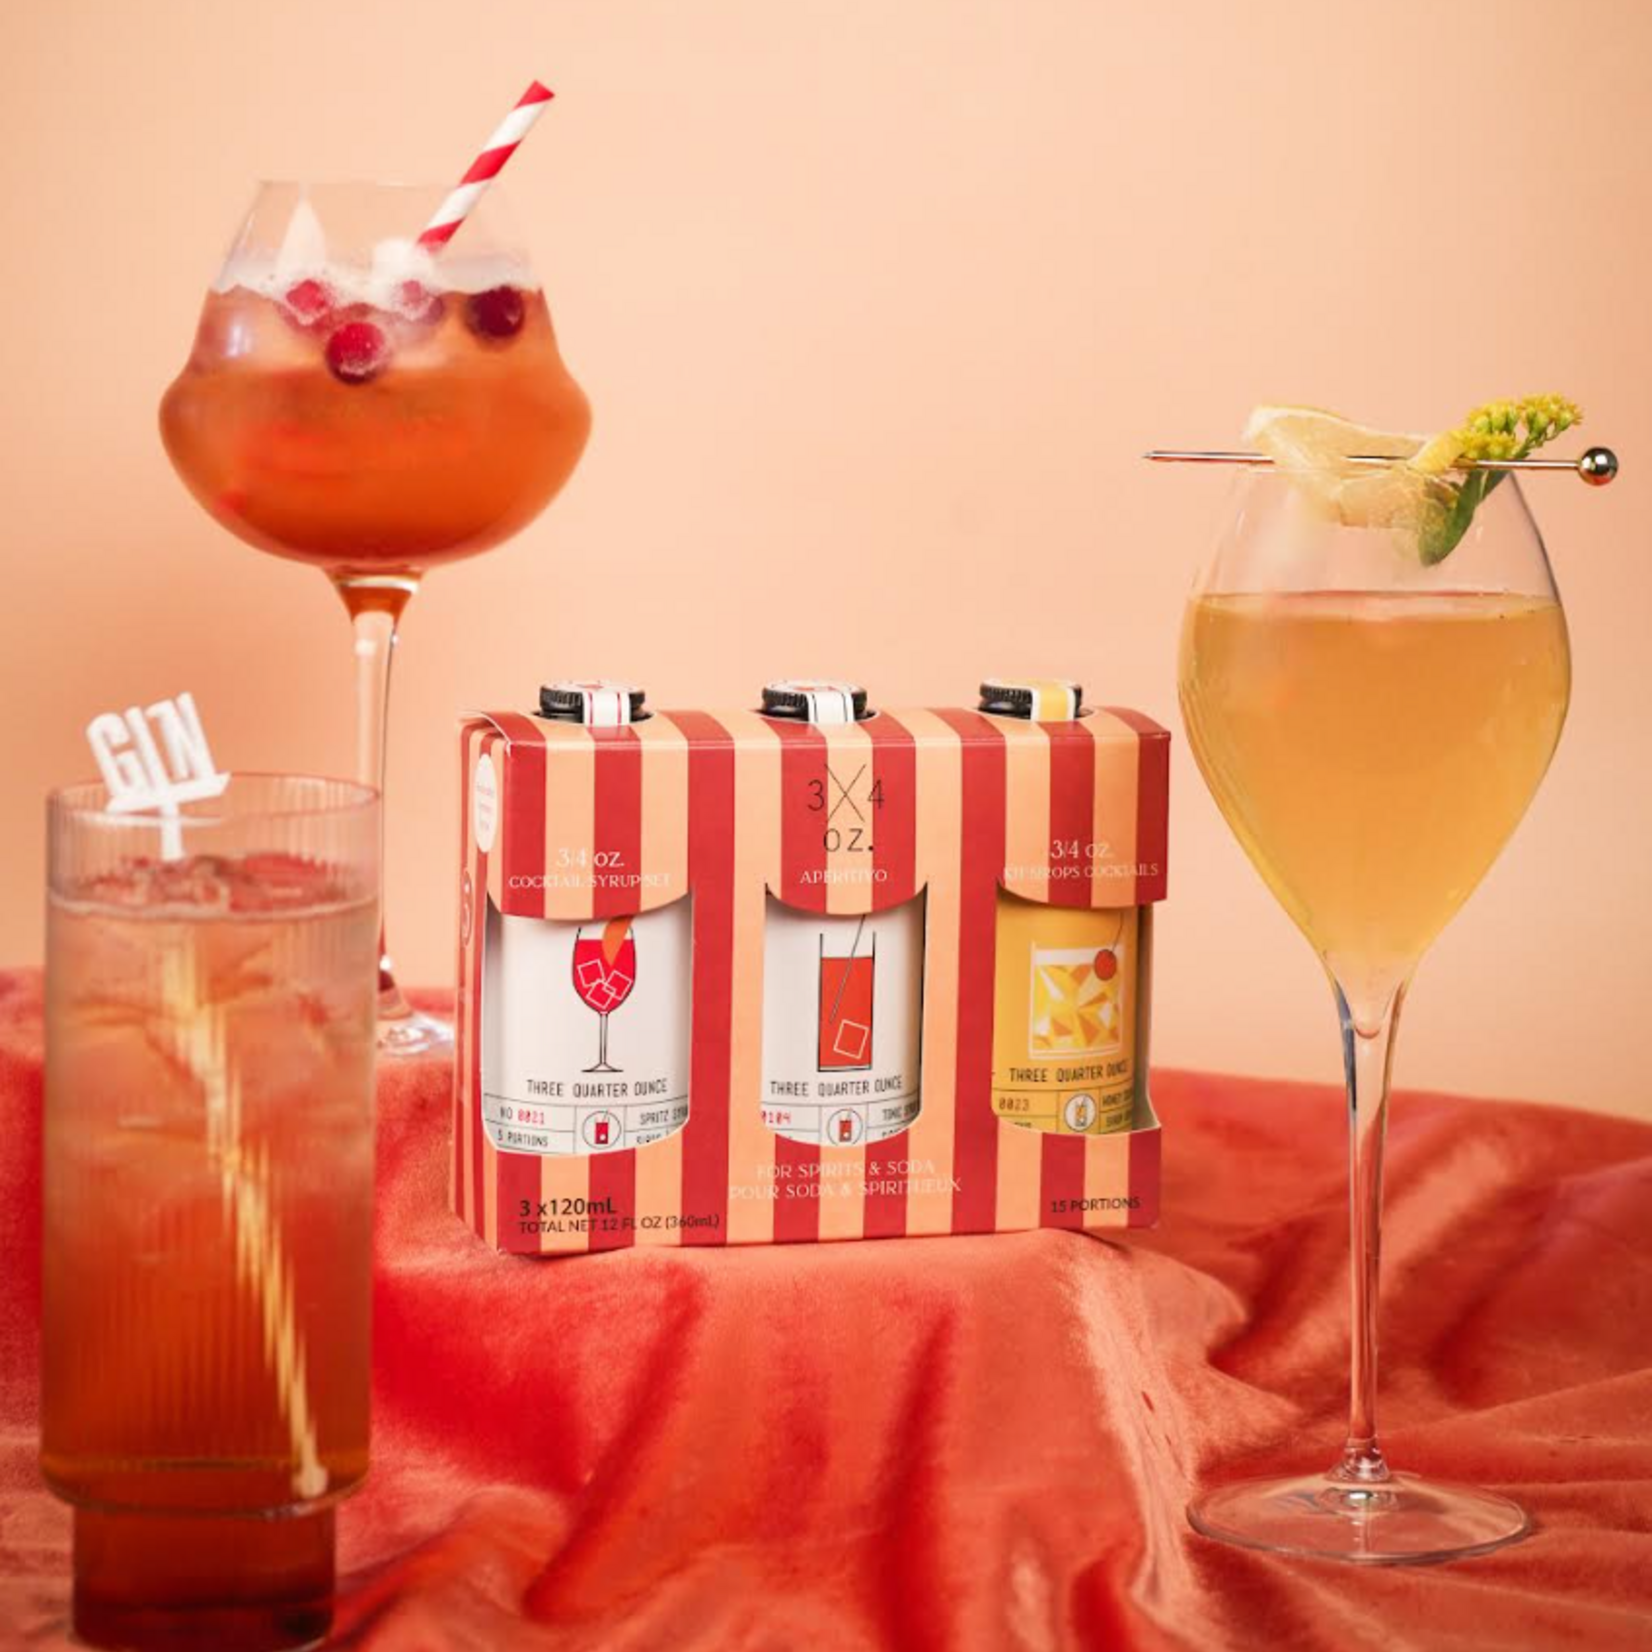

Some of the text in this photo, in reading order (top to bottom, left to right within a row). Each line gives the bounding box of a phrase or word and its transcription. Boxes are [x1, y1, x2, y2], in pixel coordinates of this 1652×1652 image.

[86, 690, 217, 798] GIN
[1051, 839, 1079, 859] 3/4
[800, 868, 888, 884] APERITIVO
[1084, 862, 1159, 878] COCKTAILS
[508, 874, 582, 889] COCKTAIL
[592, 874, 639, 888] SYRUP
[1009, 1067, 1048, 1083] THREE
[1056, 1065, 1104, 1083] QUARTER
[527, 1078, 668, 1098] THREE QUARTER OUNCE
[770, 1075, 903, 1097] THREE QUARTER OUNCE
[999, 1097, 1030, 1112] 0023
[639, 1109, 669, 1125] SPRITZ
[507, 1131, 548, 1148] PORTIONS
[757, 1159, 935, 1179] FOR SPIRITS & SODA
[730, 1184, 780, 1200] POUR
[786, 1182, 834, 1198] SODA
[860, 1176, 962, 1195] SPIRITUEUX
[1051, 1197, 1141, 1213] 15 PORTIONS
[519, 1213, 719, 1234] TOTAL NET 12 FL OZ (360mL)
